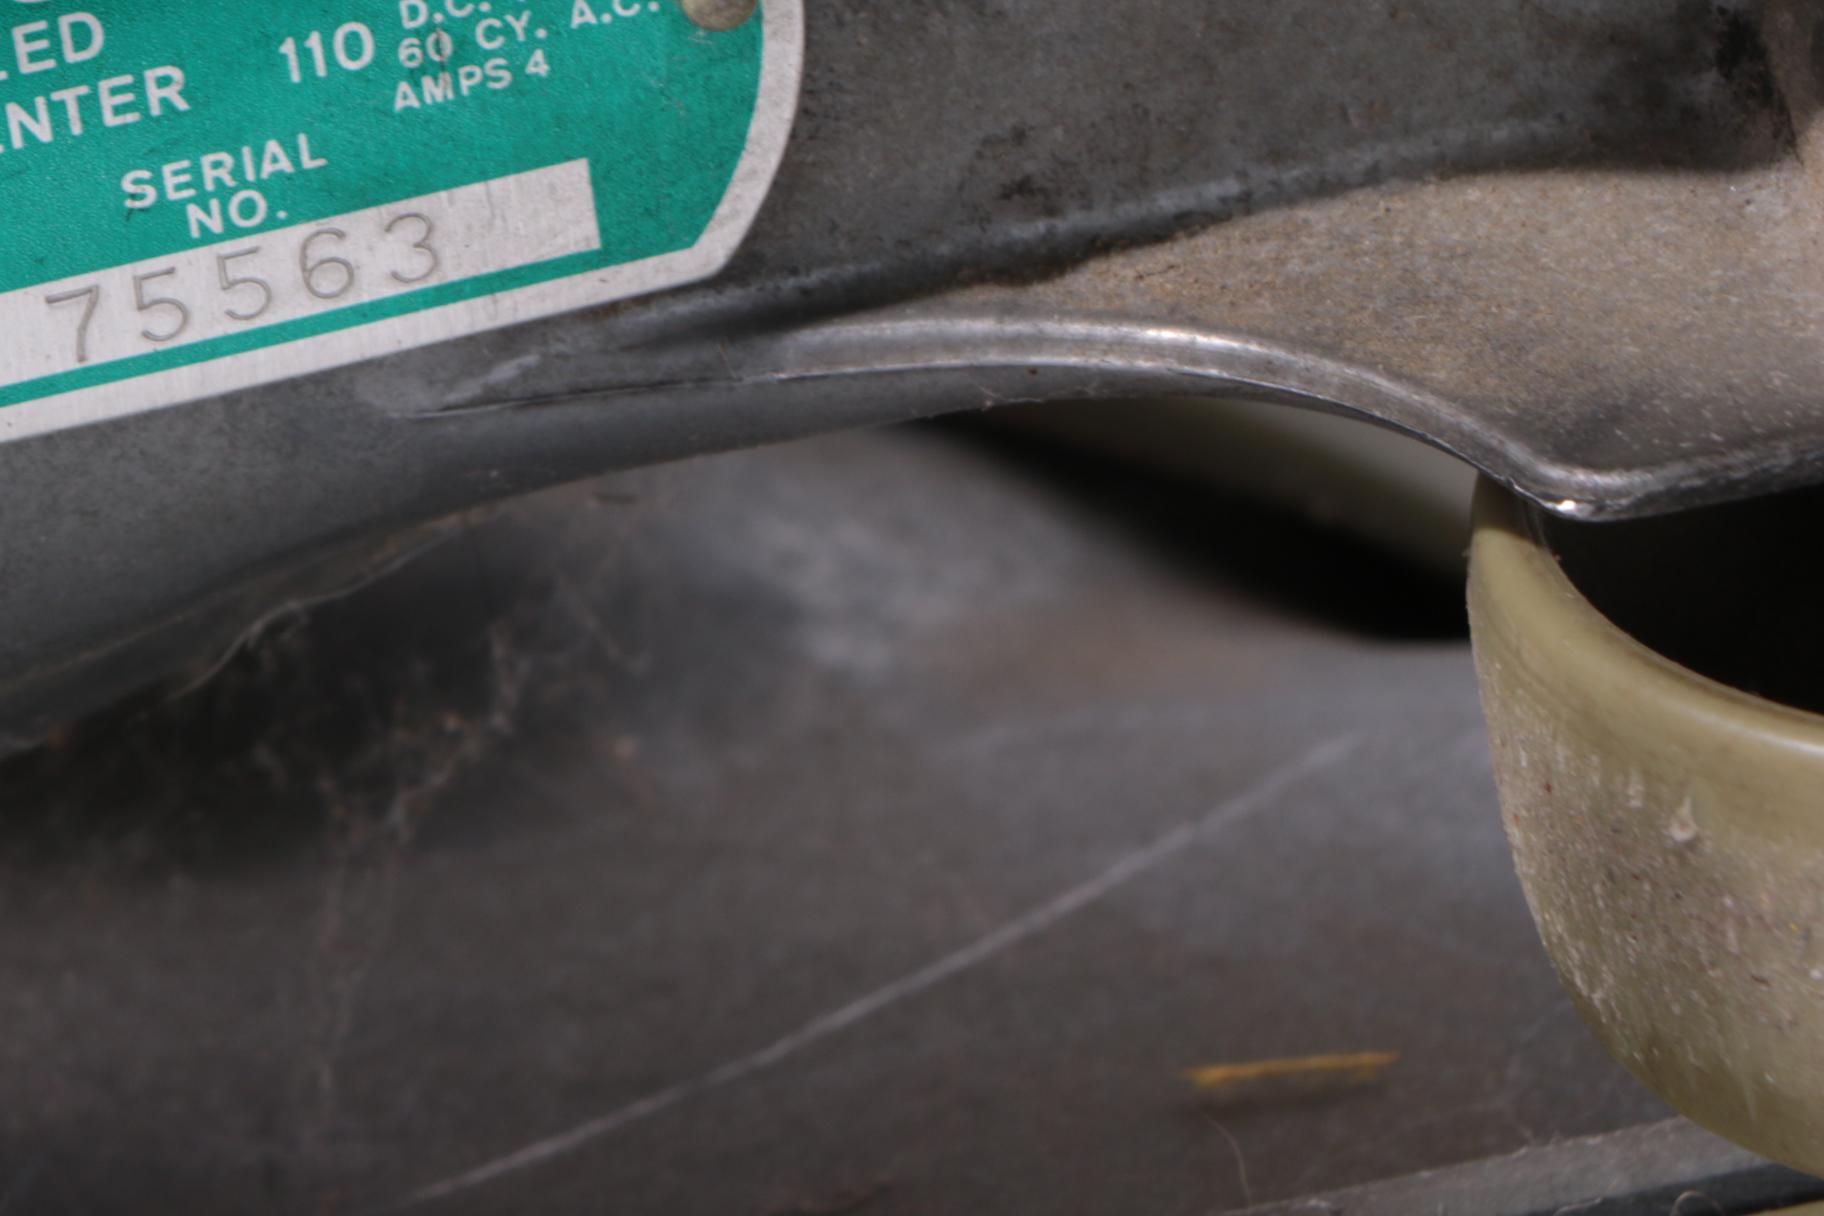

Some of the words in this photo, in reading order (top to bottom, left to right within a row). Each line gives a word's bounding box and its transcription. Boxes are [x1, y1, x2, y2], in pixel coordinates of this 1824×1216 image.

[279, 21, 375, 83] 110
[397, 30, 453, 69] 60
[476, 12, 547, 50] CY.
[393, 57, 512, 112] AMPS
[525, 49, 550, 77] 4
[121, 133, 327, 209] SERIAL
[187, 190, 287, 238] NO.
[45, 213, 439, 364] 75563
